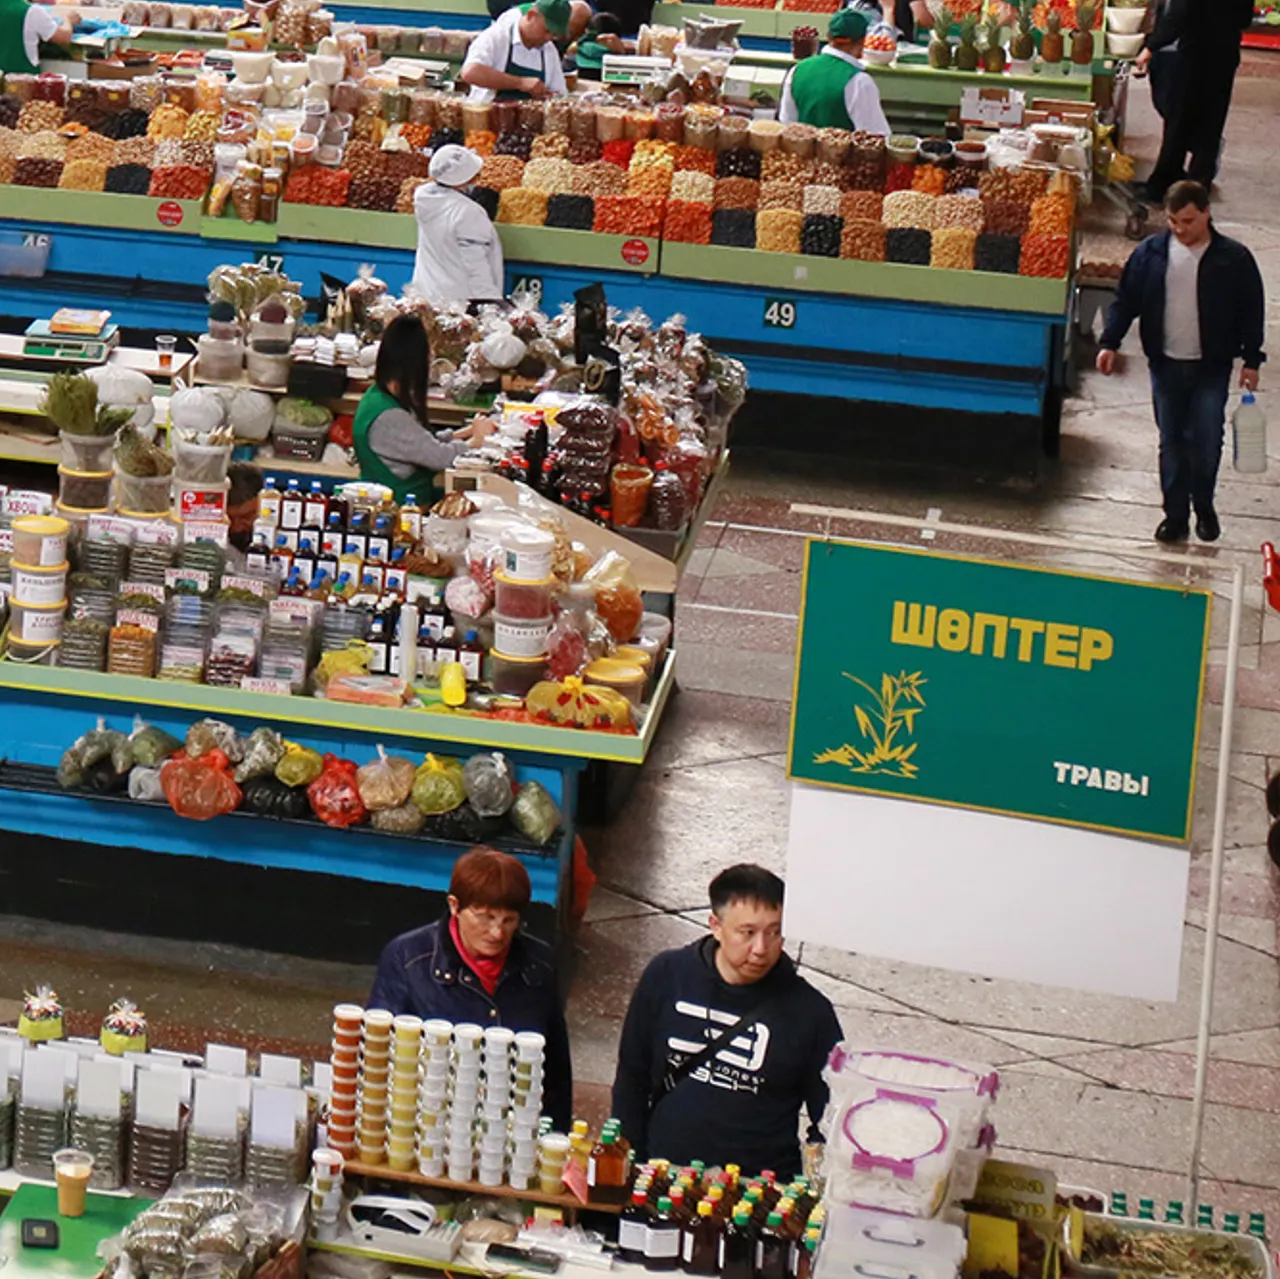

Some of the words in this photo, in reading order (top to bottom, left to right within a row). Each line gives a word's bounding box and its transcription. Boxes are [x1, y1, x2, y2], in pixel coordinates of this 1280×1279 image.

[257, 253, 283, 274] 47
[765, 302, 795, 327] 49
[890, 600, 1115, 672] ШӨПТЕР
[1053, 760, 1150, 797] ТРАВЫ
